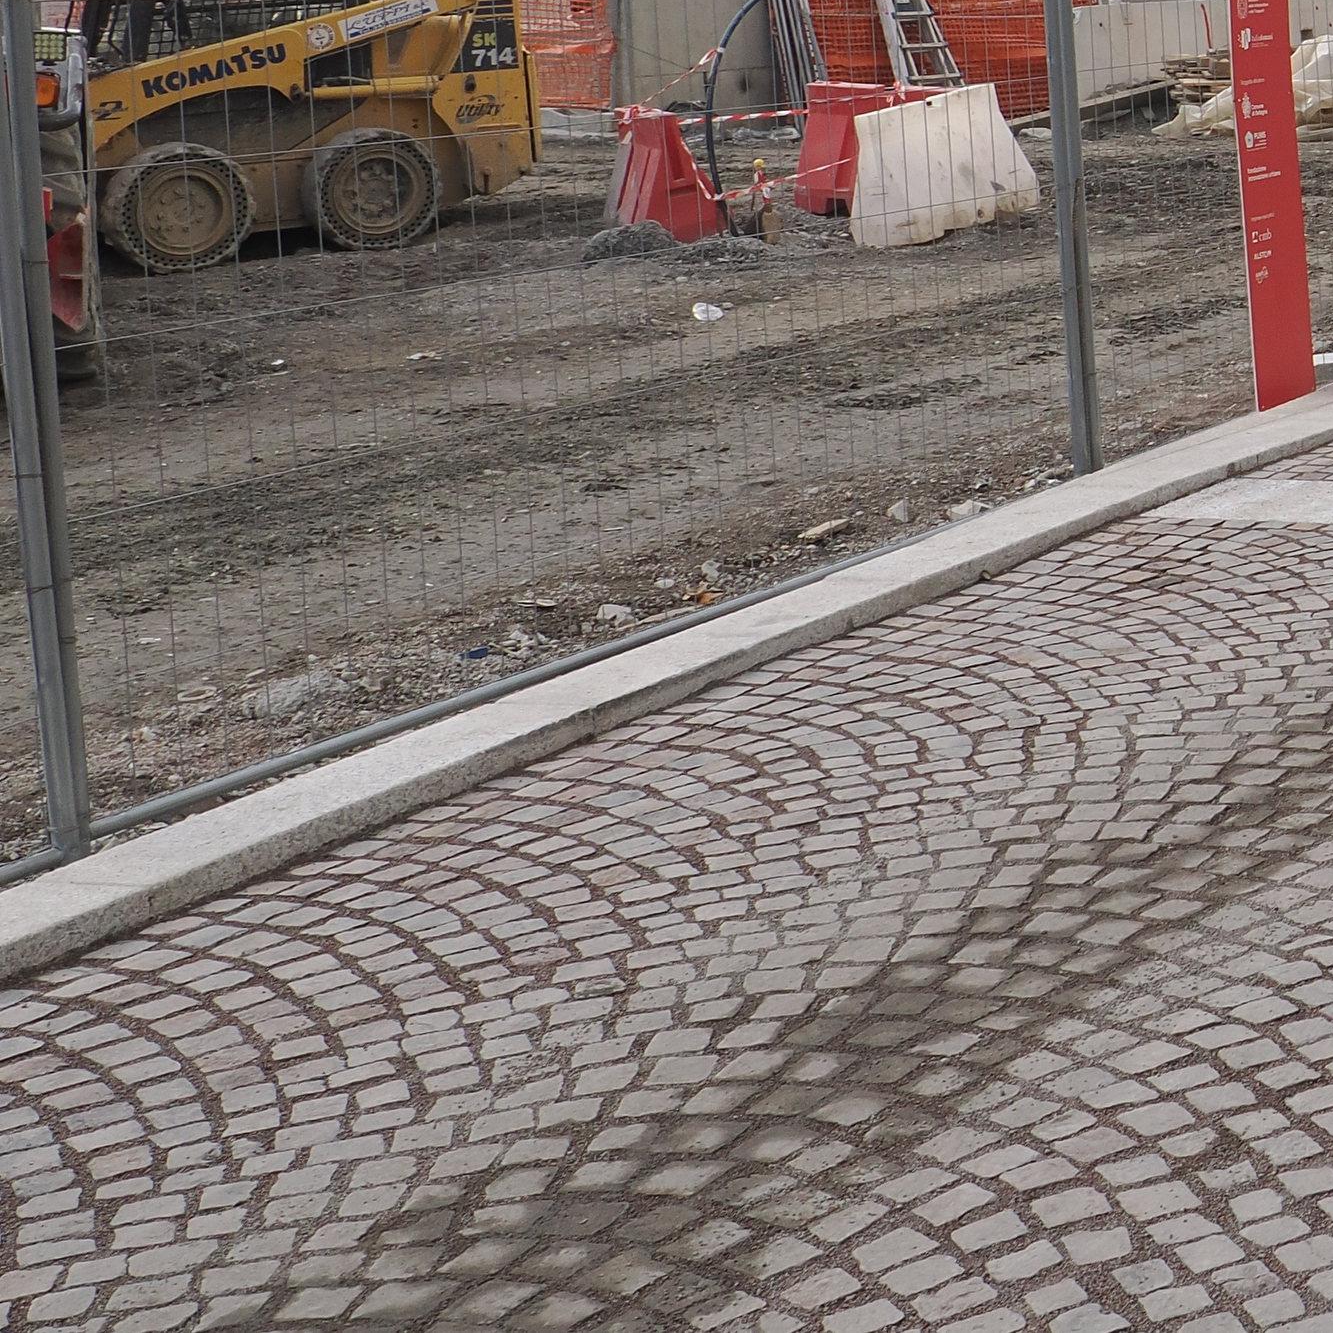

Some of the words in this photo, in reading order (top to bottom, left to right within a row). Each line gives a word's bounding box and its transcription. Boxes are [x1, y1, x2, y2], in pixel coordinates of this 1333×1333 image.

[472, 31, 497, 47] SK
[471, 47, 515, 67] 714
[141, 43, 286, 98] KOMATSU
